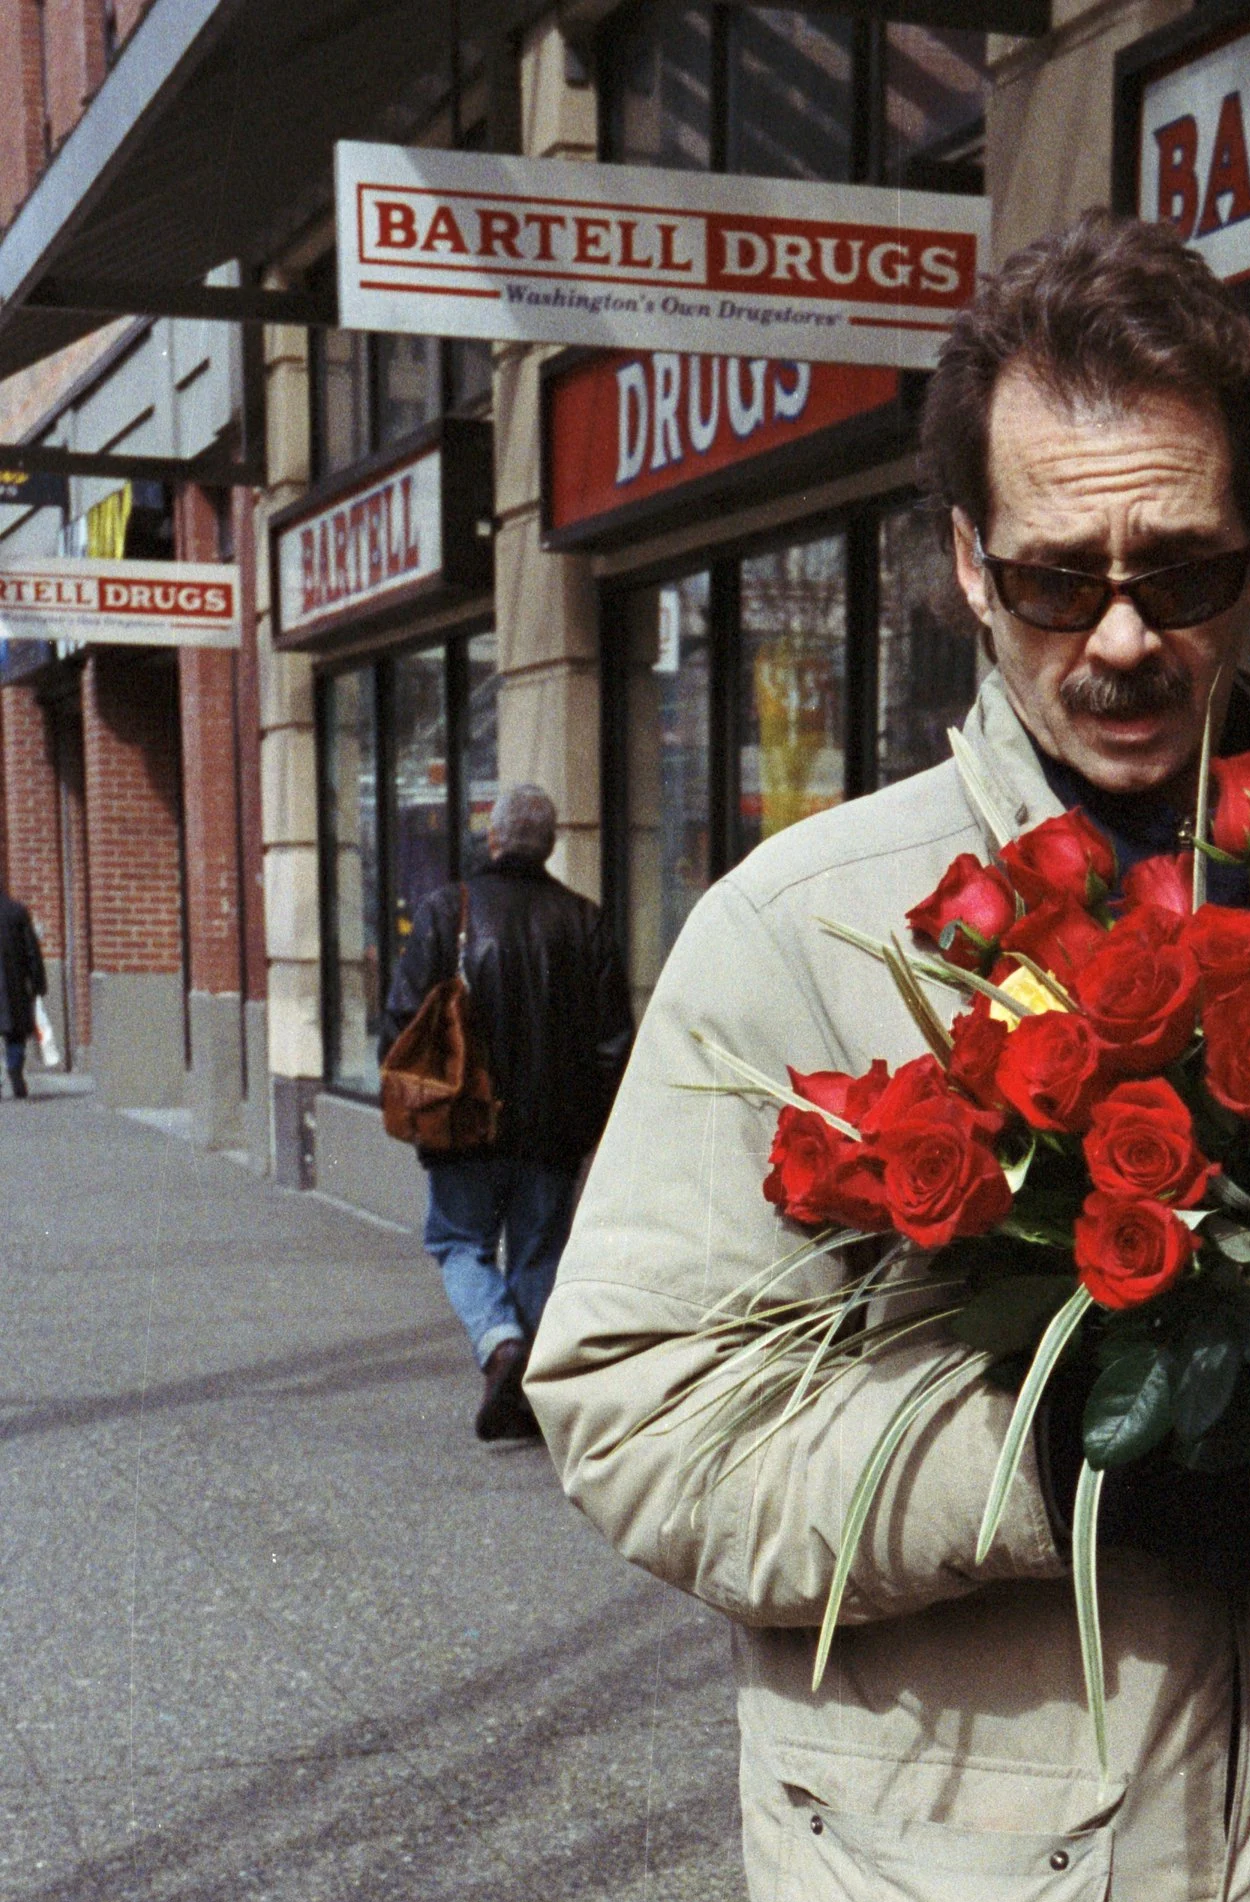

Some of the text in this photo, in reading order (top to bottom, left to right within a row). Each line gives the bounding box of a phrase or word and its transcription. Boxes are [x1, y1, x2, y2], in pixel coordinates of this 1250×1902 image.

[374, 200, 961, 294] BARTELL DRUGS
[504, 283, 838, 327] Washington's Own Drugstores
[301, 475, 420, 614] BARTELL
[103, 583, 227, 612] DRUGS
